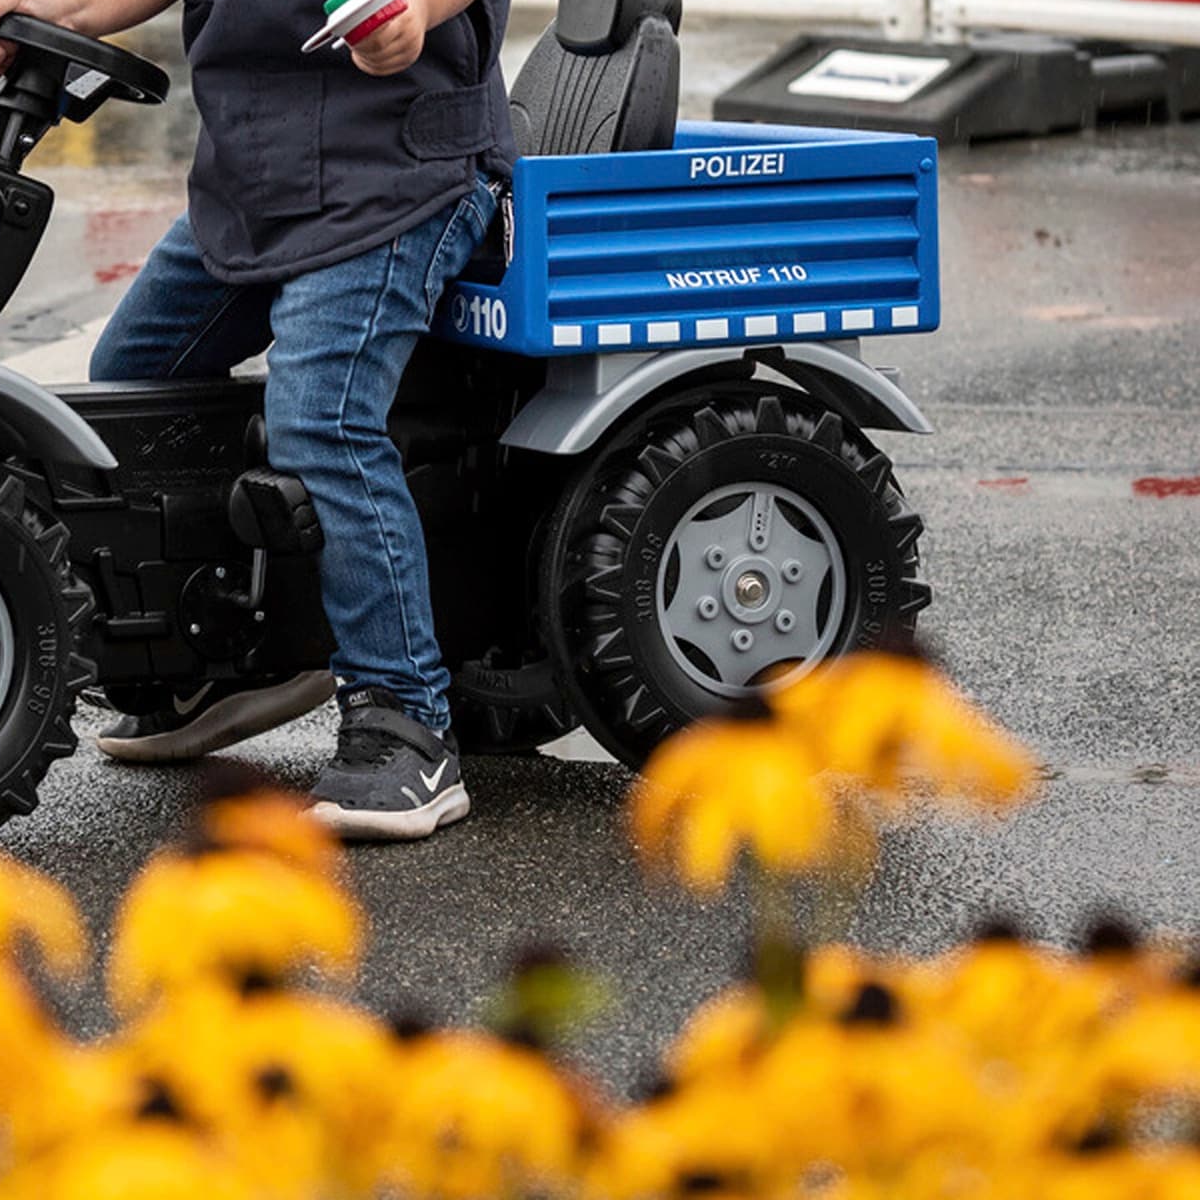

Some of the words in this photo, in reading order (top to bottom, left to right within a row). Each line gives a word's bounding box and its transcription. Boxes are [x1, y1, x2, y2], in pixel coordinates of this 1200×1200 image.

[691, 153, 784, 179] POLIZEI
[666, 268, 761, 289] NOTRUF
[767, 265, 808, 282] 110
[470, 296, 507, 340] 110
